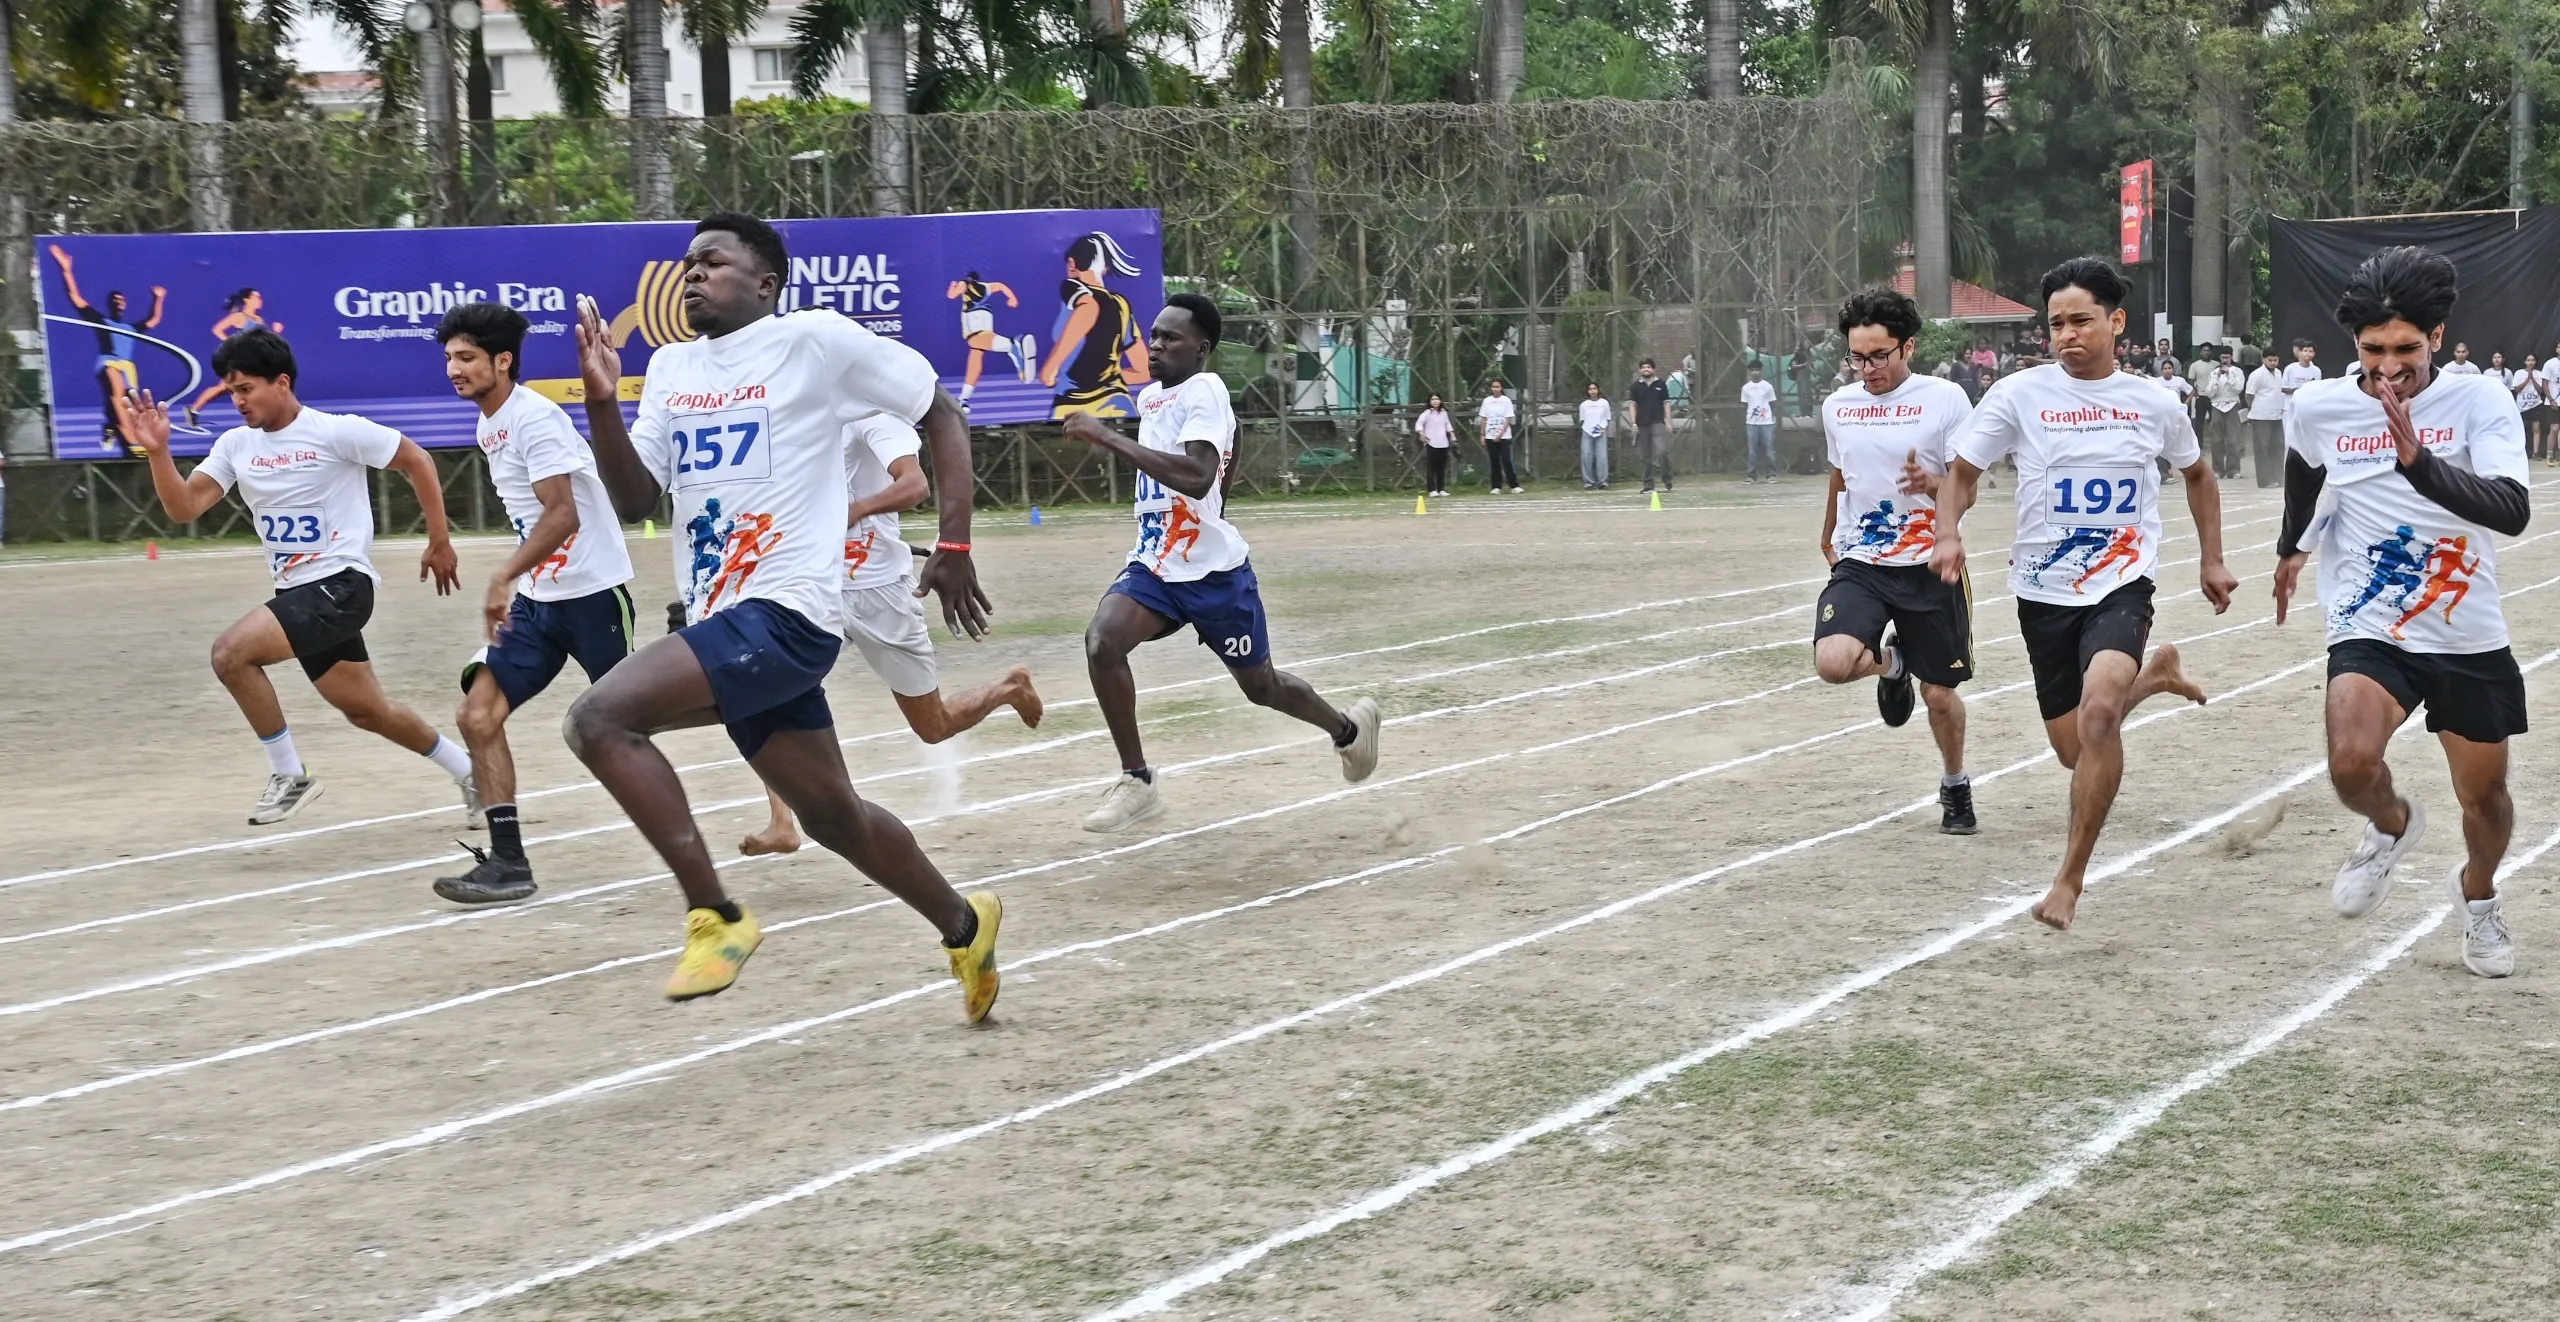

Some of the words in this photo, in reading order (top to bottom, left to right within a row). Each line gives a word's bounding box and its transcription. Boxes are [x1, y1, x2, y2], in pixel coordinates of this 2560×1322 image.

[786, 254, 898, 285] NUAL
[496, 282, 567, 312] Era
[338, 326, 436, 341] Transforming
[864, 320, 903, 333] 2026
[732, 384, 766, 402] Era
[1836, 405, 1891, 421] Graphic
[1896, 405, 1922, 417] Era
[2040, 406, 2107, 426] Graphic
[2044, 426, 2083, 434] Transforming
[2336, 431, 2396, 454] Graph
[2419, 427, 2454, 445] Era
[295, 450, 317, 462] Era
[671, 421, 760, 475] 257
[2337, 456, 2381, 465] Transforming
[2383, 453, 2399, 462] dre
[1135, 471, 1165, 503] 01
[2053, 478, 2137, 515] 192
[261, 515, 321, 543] 223
[1224, 634, 1252, 658] 20
